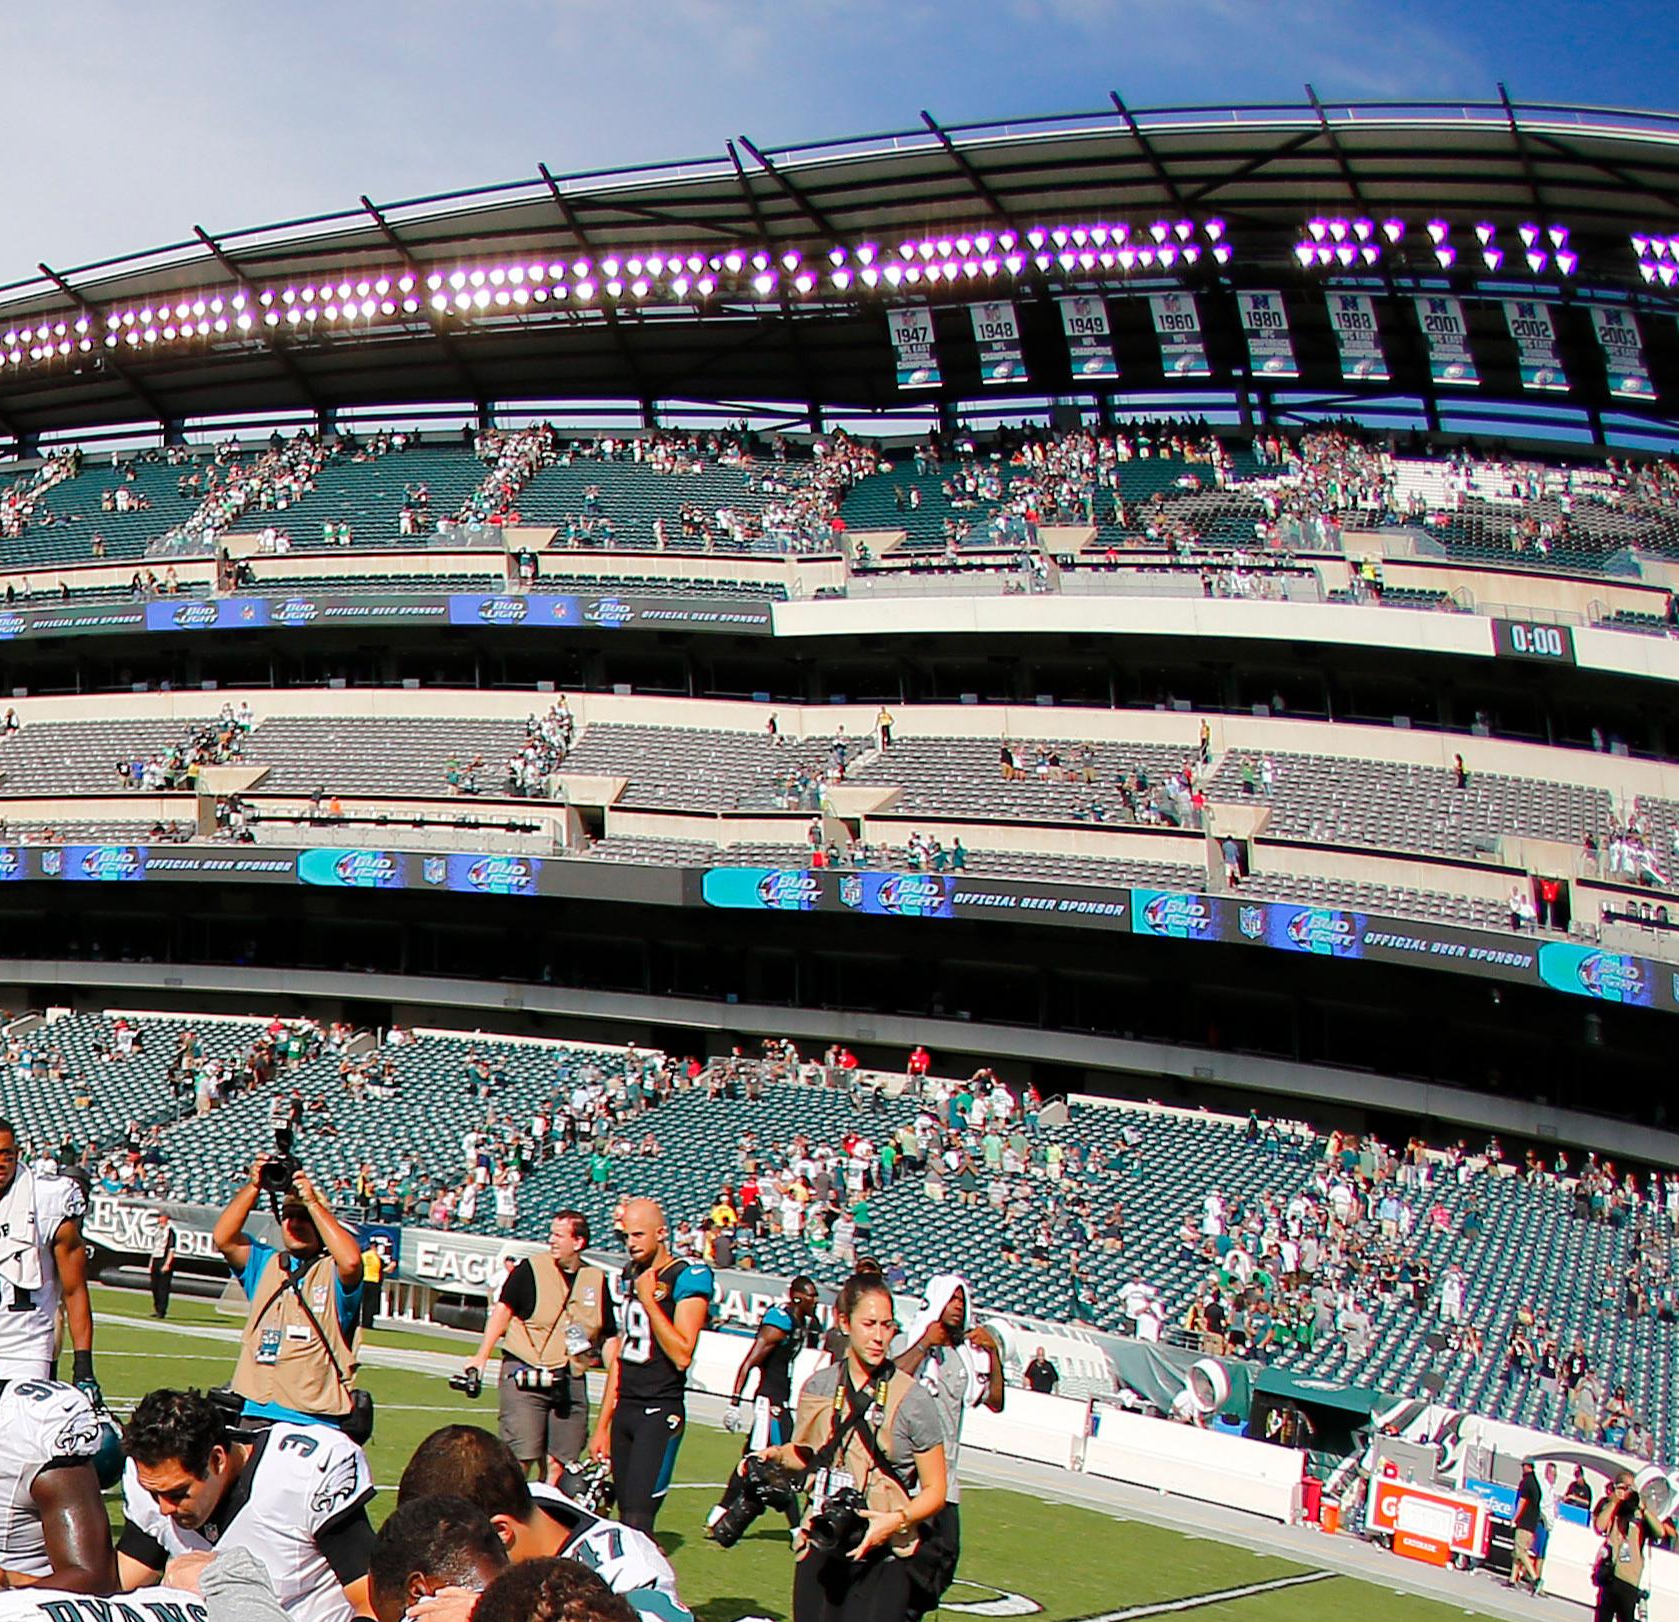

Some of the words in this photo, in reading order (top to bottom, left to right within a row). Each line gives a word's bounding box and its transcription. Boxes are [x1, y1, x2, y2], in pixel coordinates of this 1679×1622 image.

[1069, 317, 1104, 334] 1949
[1160, 314, 1194, 331] 1960
[1246, 311, 1282, 328] 1980
[1335, 312, 1371, 329] 1988
[1424, 315, 1459, 333] 2001
[895, 327, 928, 344] 1947
[979, 322, 1013, 339] 1948
[1512, 320, 1549, 338] 2002
[1600, 326, 1636, 346] 2003
[184, 606, 215, 615] BUD
[284, 603, 316, 612] BUD
[493, 602, 523, 612] BUD
[600, 602, 631, 612] BUD
[172, 613, 218, 625] LIGHT
[271, 610, 319, 621] LIGHT
[480, 610, 528, 621] LIGHT
[584, 610, 635, 622] LIGHT
[1511, 625, 1563, 657] 0:00
[780, 876, 818, 890] BUD
[900, 880, 939, 894] BUD
[768, 887, 823, 902] LIGHT
[890, 893, 945, 908] LIGHT
[953, 892, 1016, 907] OFFICIAL
[1166, 900, 1205, 917] BUD
[1153, 914, 1210, 931] LIGHT
[89, 1196, 158, 1241] Eye
